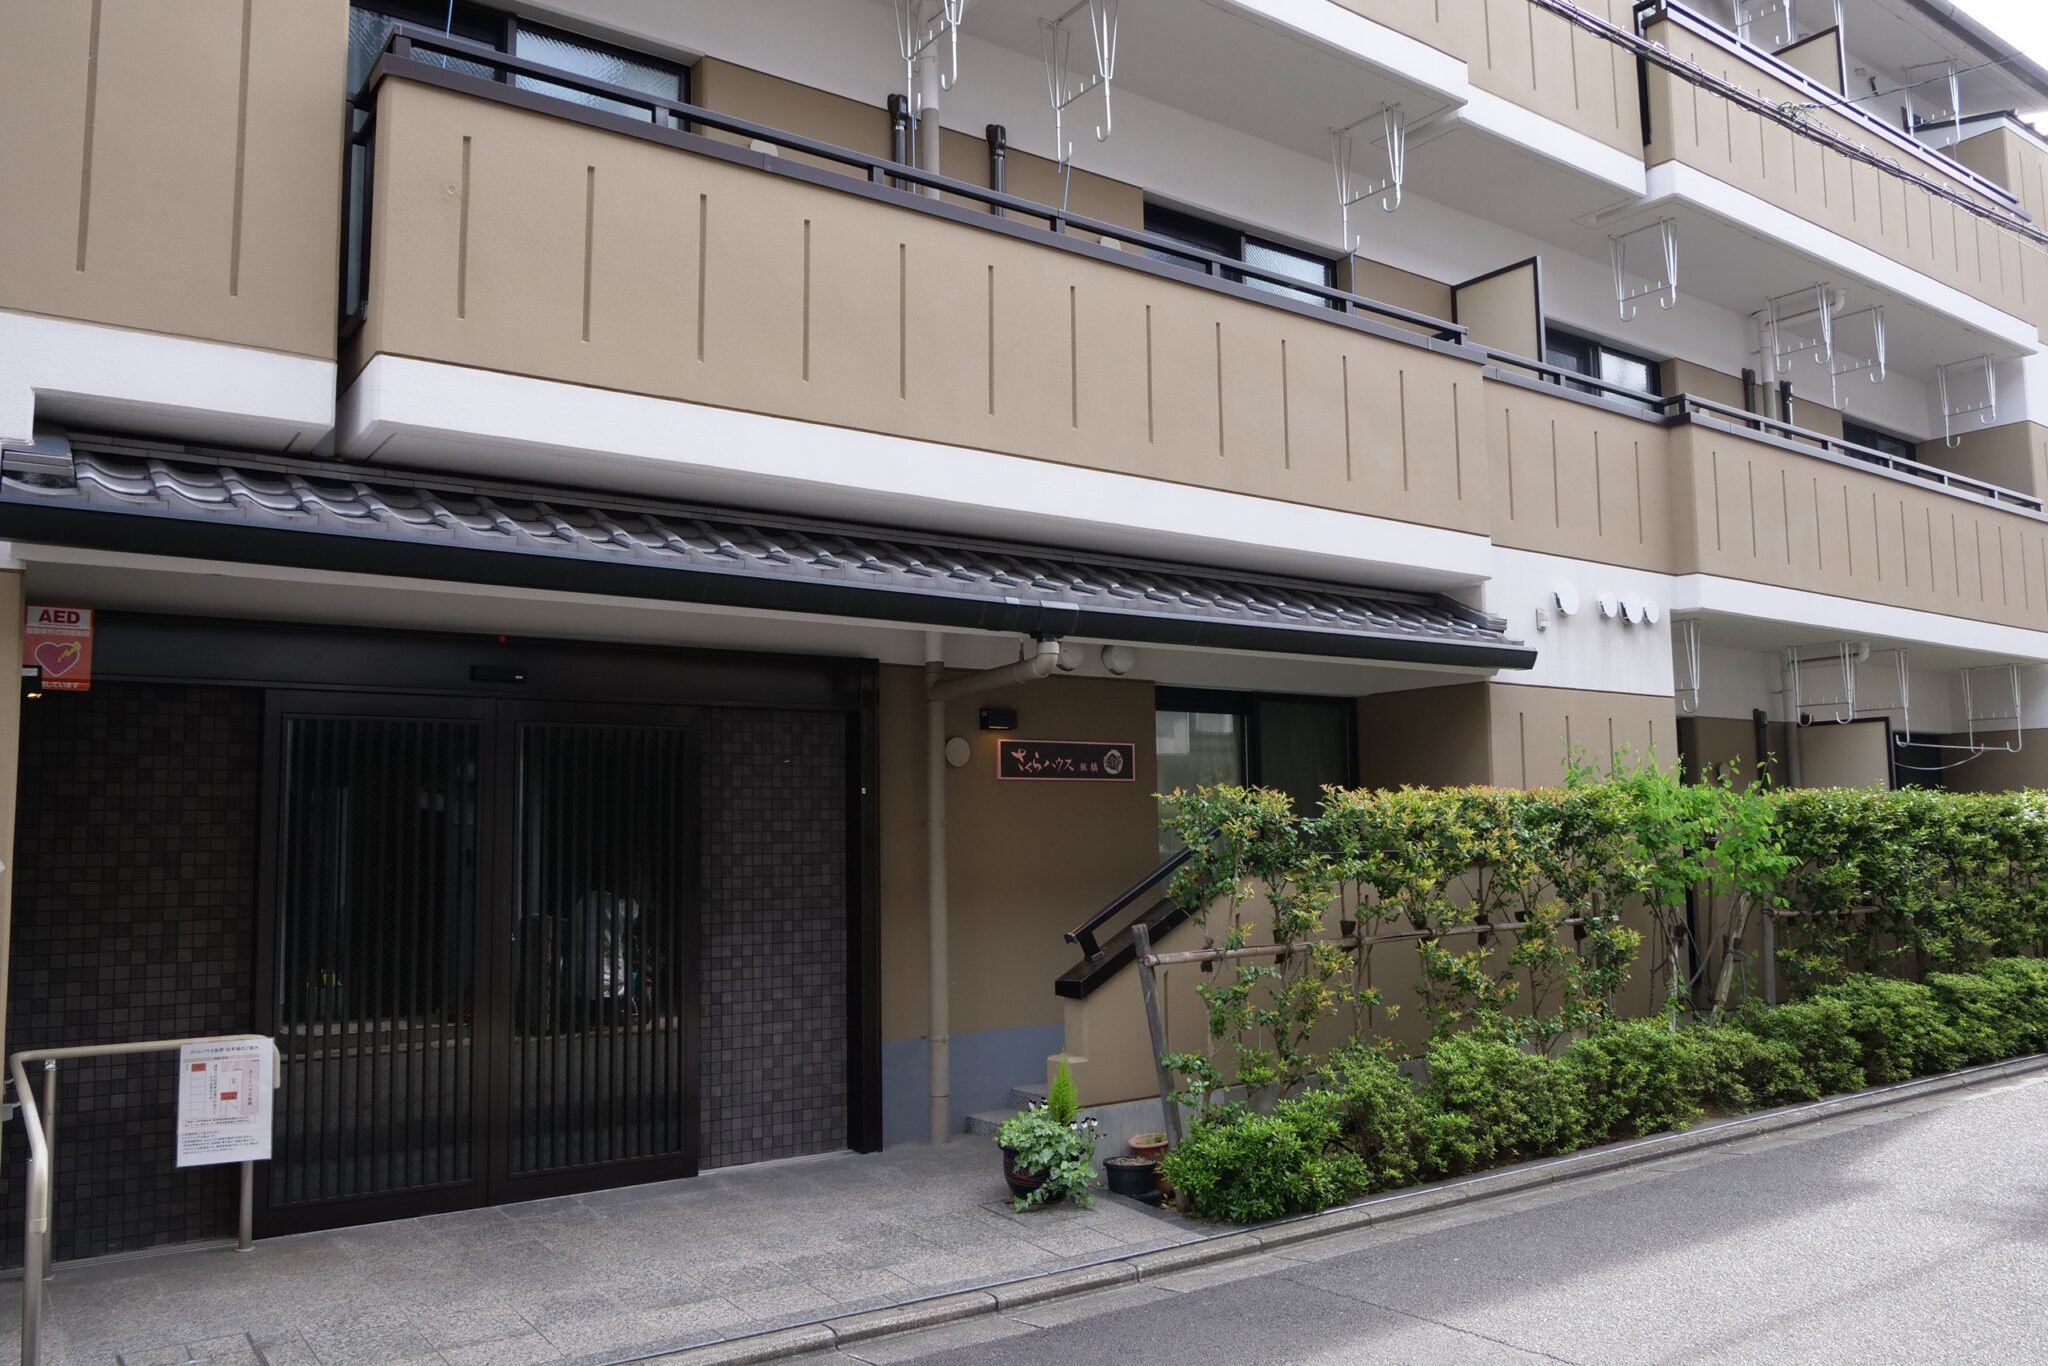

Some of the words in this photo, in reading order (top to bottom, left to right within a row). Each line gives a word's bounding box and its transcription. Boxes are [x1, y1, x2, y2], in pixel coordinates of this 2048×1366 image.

[38, 609, 80, 624] AED
[1010, 748, 1074, 773] さくらハウス
